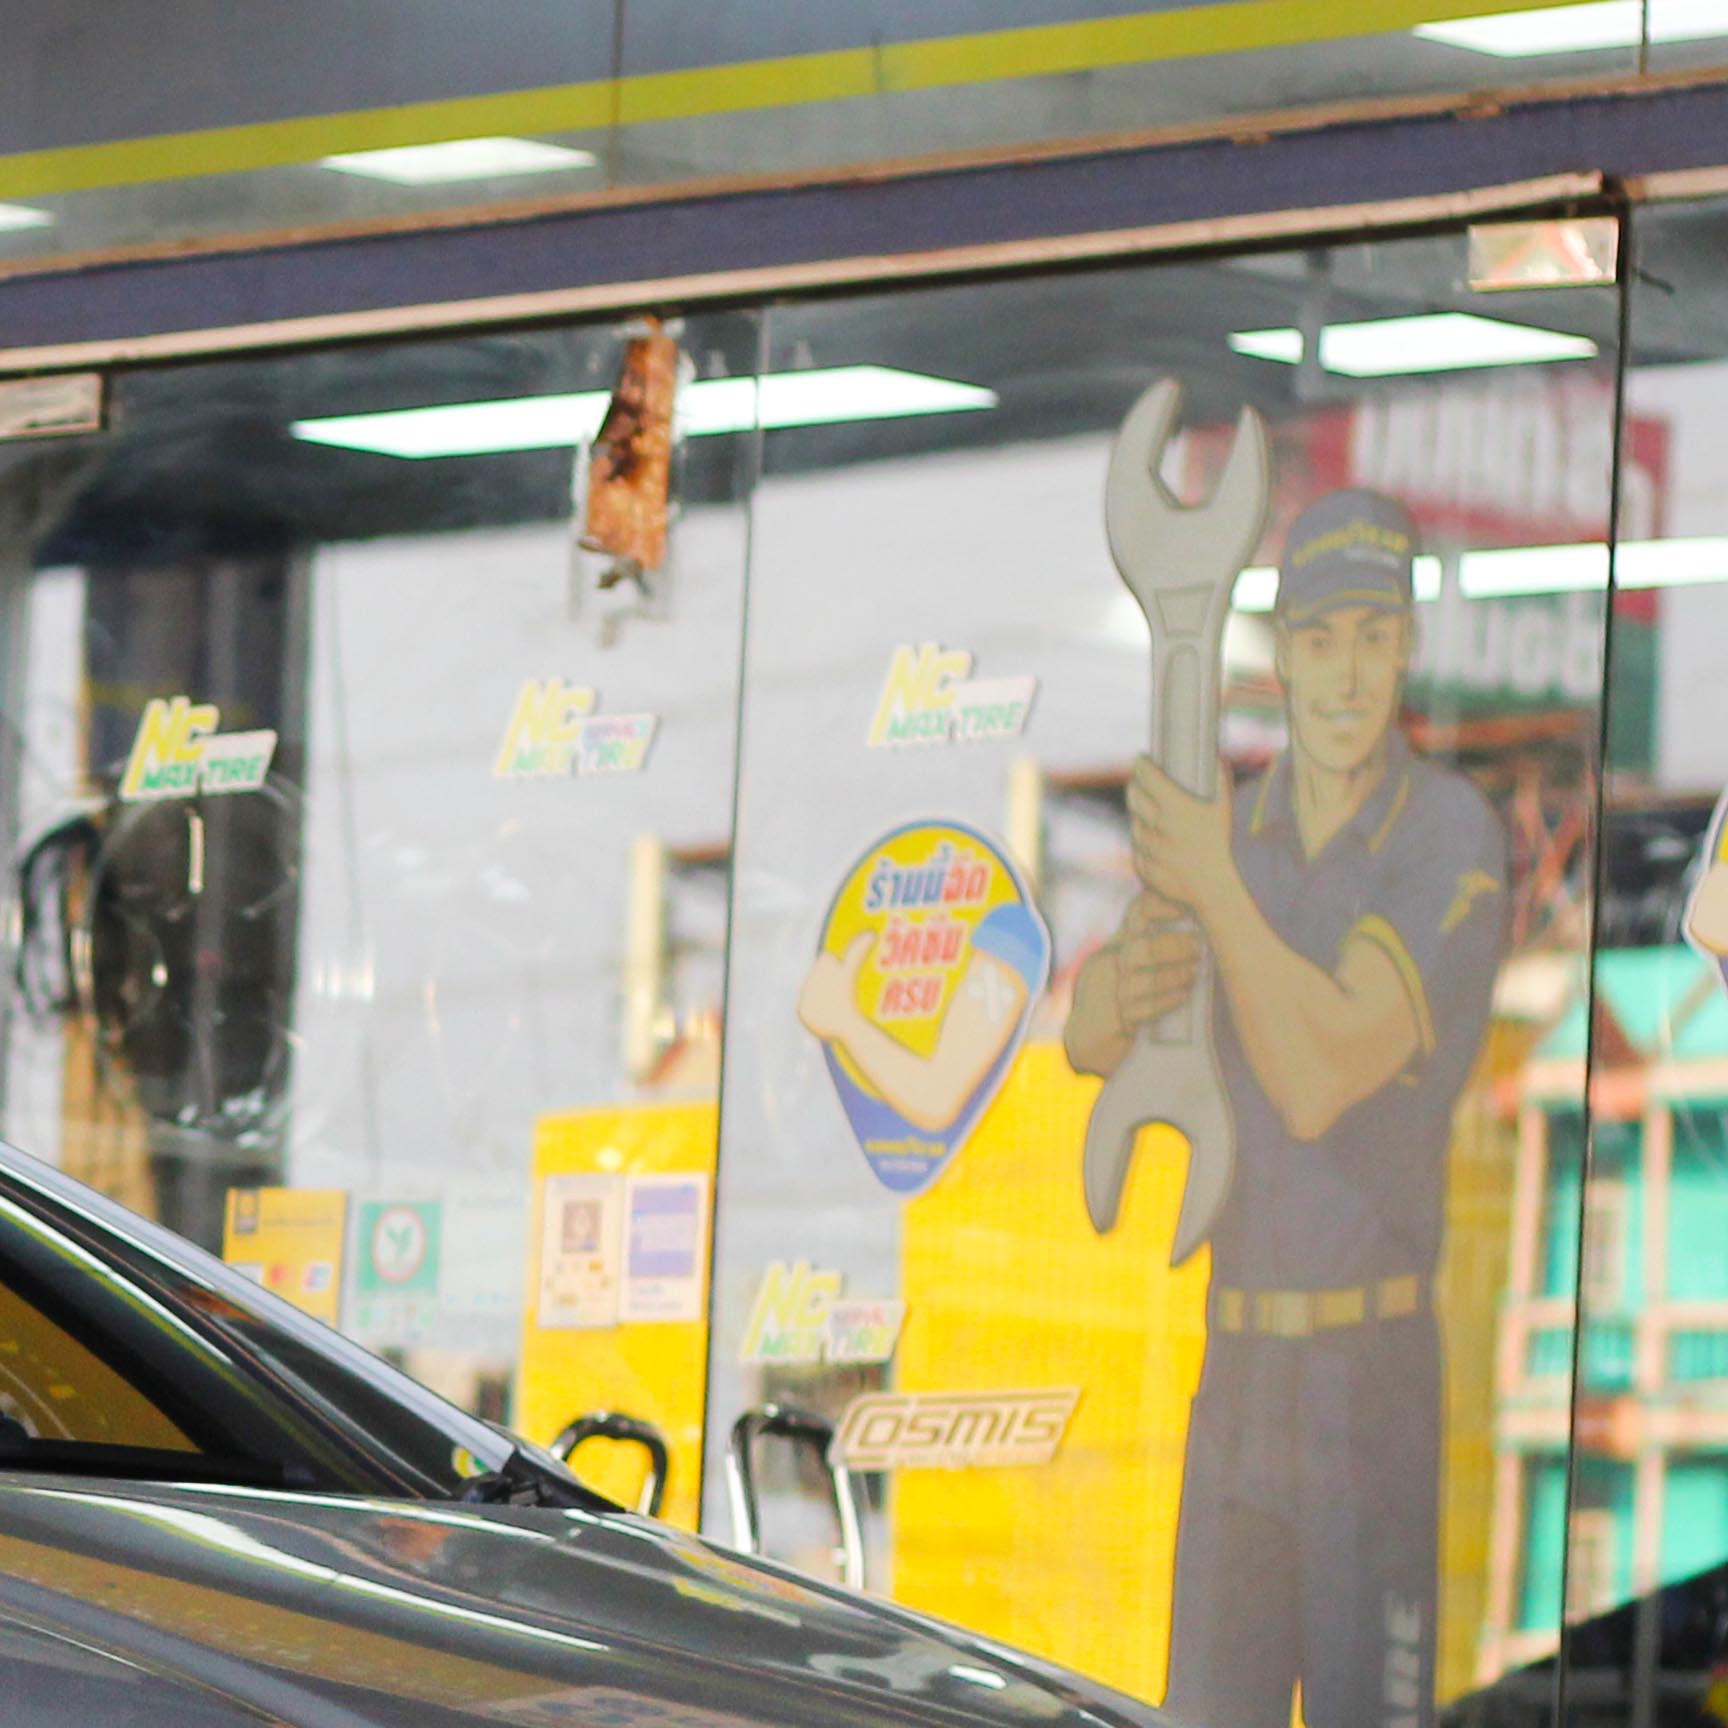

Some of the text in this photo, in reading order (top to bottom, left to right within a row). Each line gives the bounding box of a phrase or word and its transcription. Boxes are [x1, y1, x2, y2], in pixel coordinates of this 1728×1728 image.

[496, 684, 590, 773] NC
[869, 648, 969, 744] NC
[126, 700, 214, 793] NC
[743, 1263, 840, 1357] NC
[846, 1389, 1071, 1463] COSMIS
